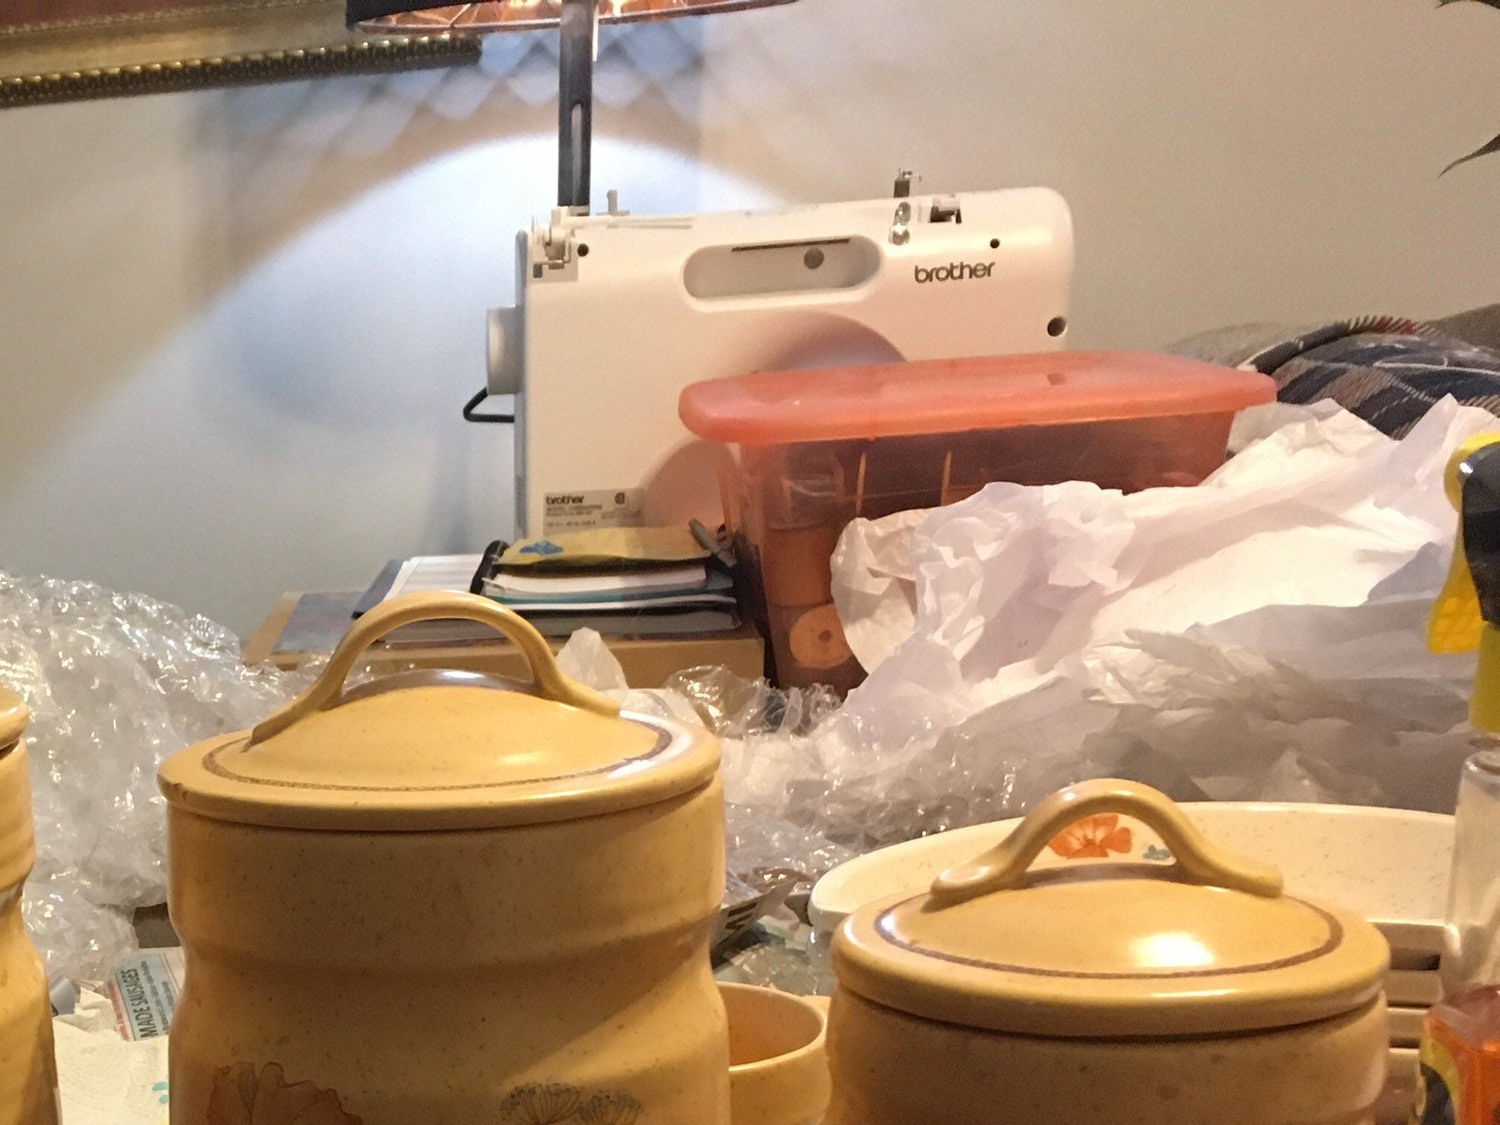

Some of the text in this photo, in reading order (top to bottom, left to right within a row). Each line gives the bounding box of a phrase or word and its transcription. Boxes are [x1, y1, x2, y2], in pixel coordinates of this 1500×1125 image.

[914, 261, 996, 283] brother
[545, 495, 585, 505] brother
[121, 968, 149, 1007] SAUSAGES
[133, 1005, 159, 1038] MADE
